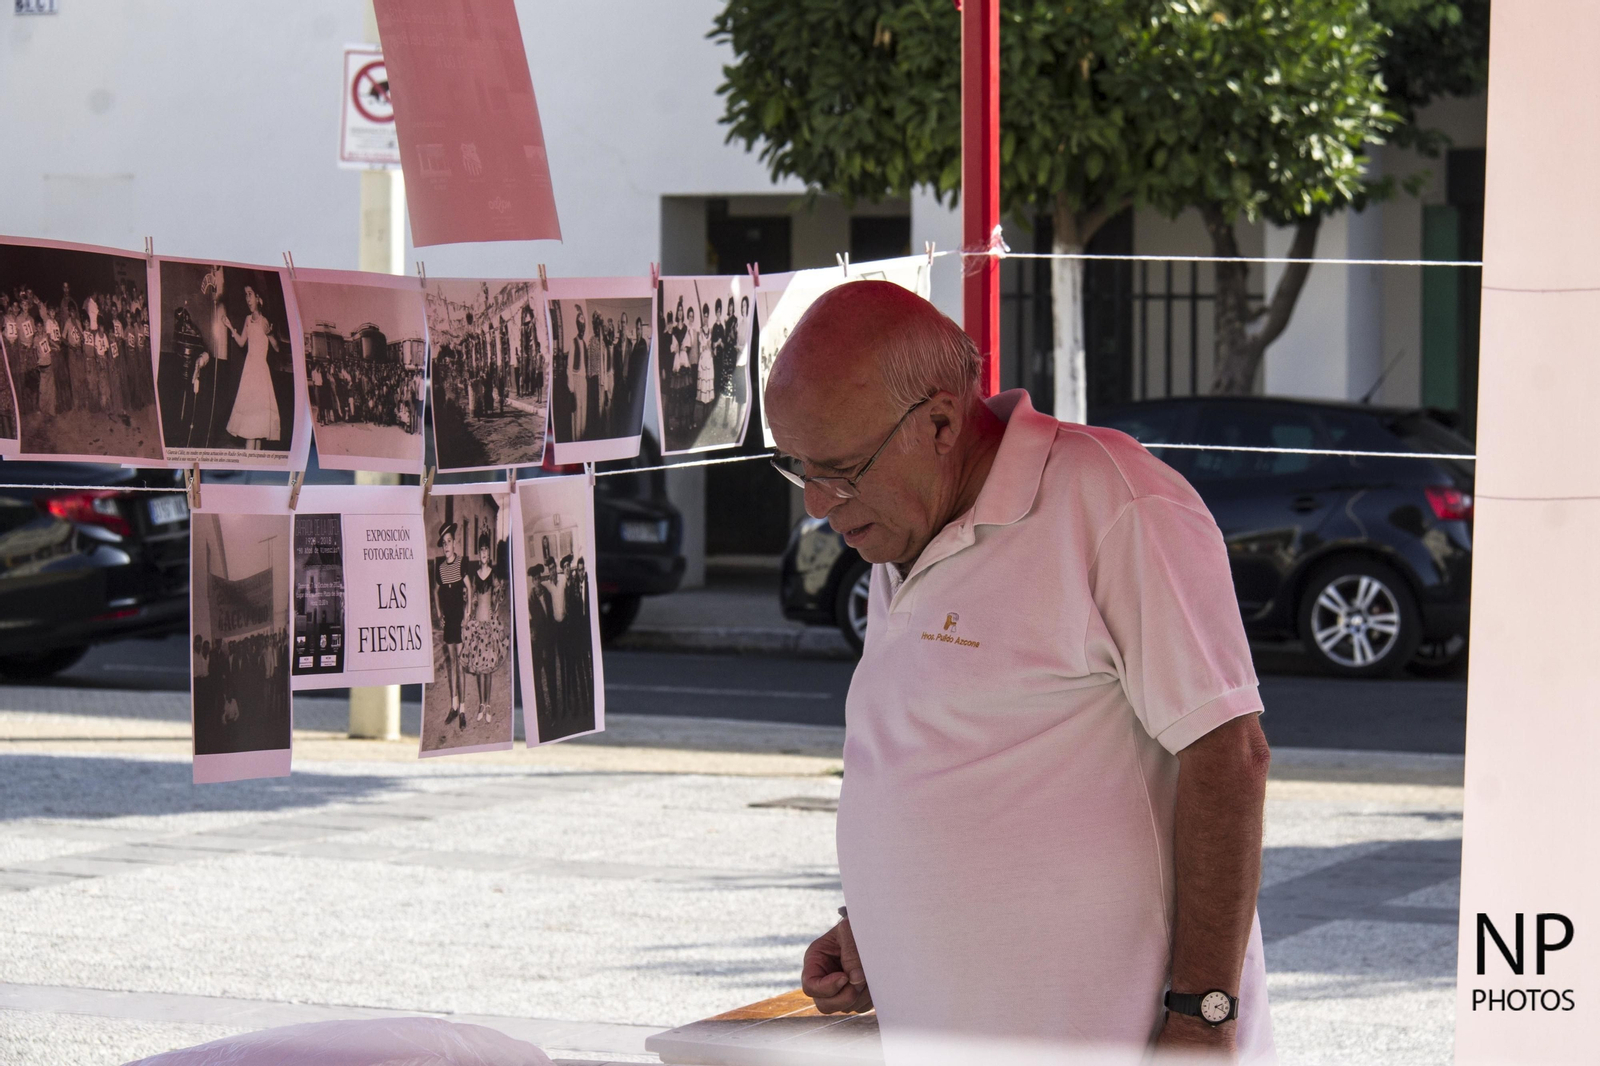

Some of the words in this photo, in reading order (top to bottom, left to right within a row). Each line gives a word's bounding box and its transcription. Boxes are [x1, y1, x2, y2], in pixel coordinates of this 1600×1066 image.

[366, 526, 410, 541] EXPOSICIÓN
[363, 544, 414, 560] FOTOGRÁFICA
[376, 582, 407, 609] LAS
[358, 624, 422, 653] FIESTAS
